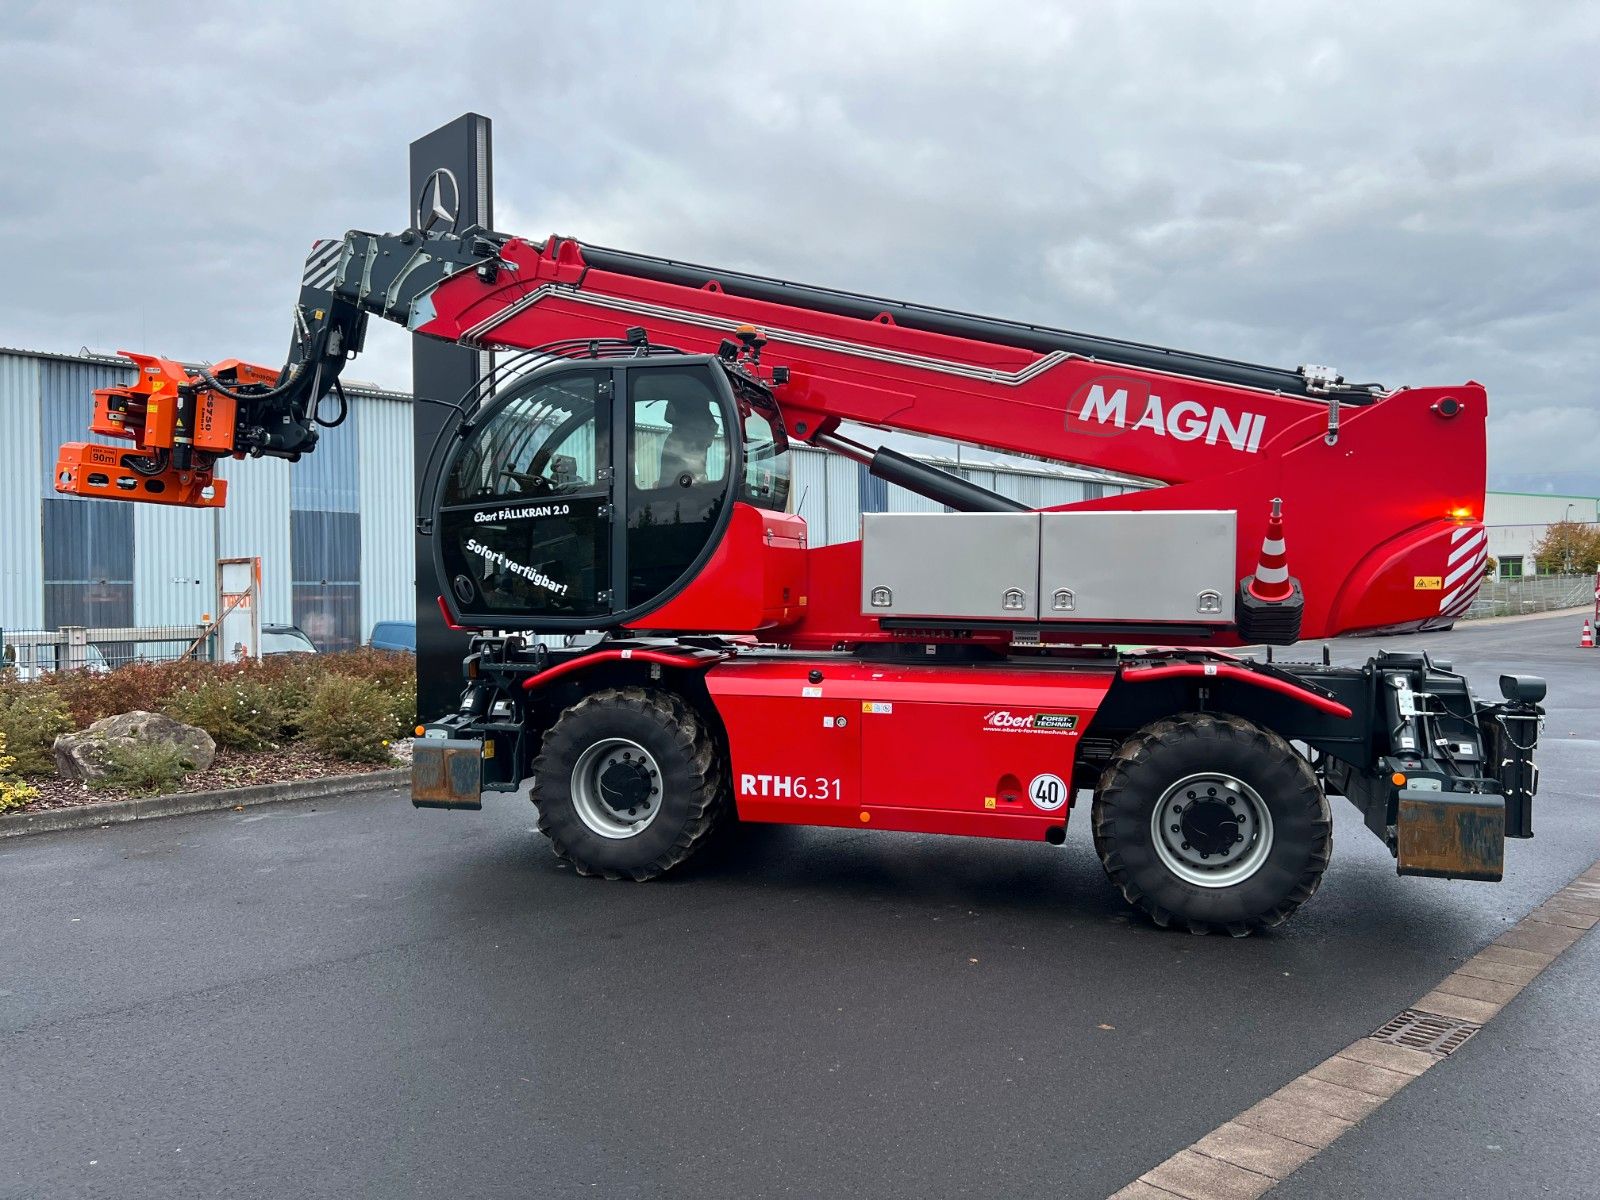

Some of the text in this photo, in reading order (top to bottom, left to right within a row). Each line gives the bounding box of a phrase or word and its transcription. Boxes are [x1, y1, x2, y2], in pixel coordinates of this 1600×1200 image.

[1078, 385, 1266, 453] MAGNI
[93, 453, 114, 463] 90m
[474, 504, 570, 522] Ebert FÄLLKRAN 2.0
[466, 539, 568, 596] Sofort verfügbar!
[994, 711, 1034, 727] Ebert
[1037, 720, 1072, 728] TECHNIK
[983, 727, 1078, 736] www.ebert-forsttechnik.de
[741, 773, 841, 800] RTH6.31
[1036, 780, 1058, 803] 40
